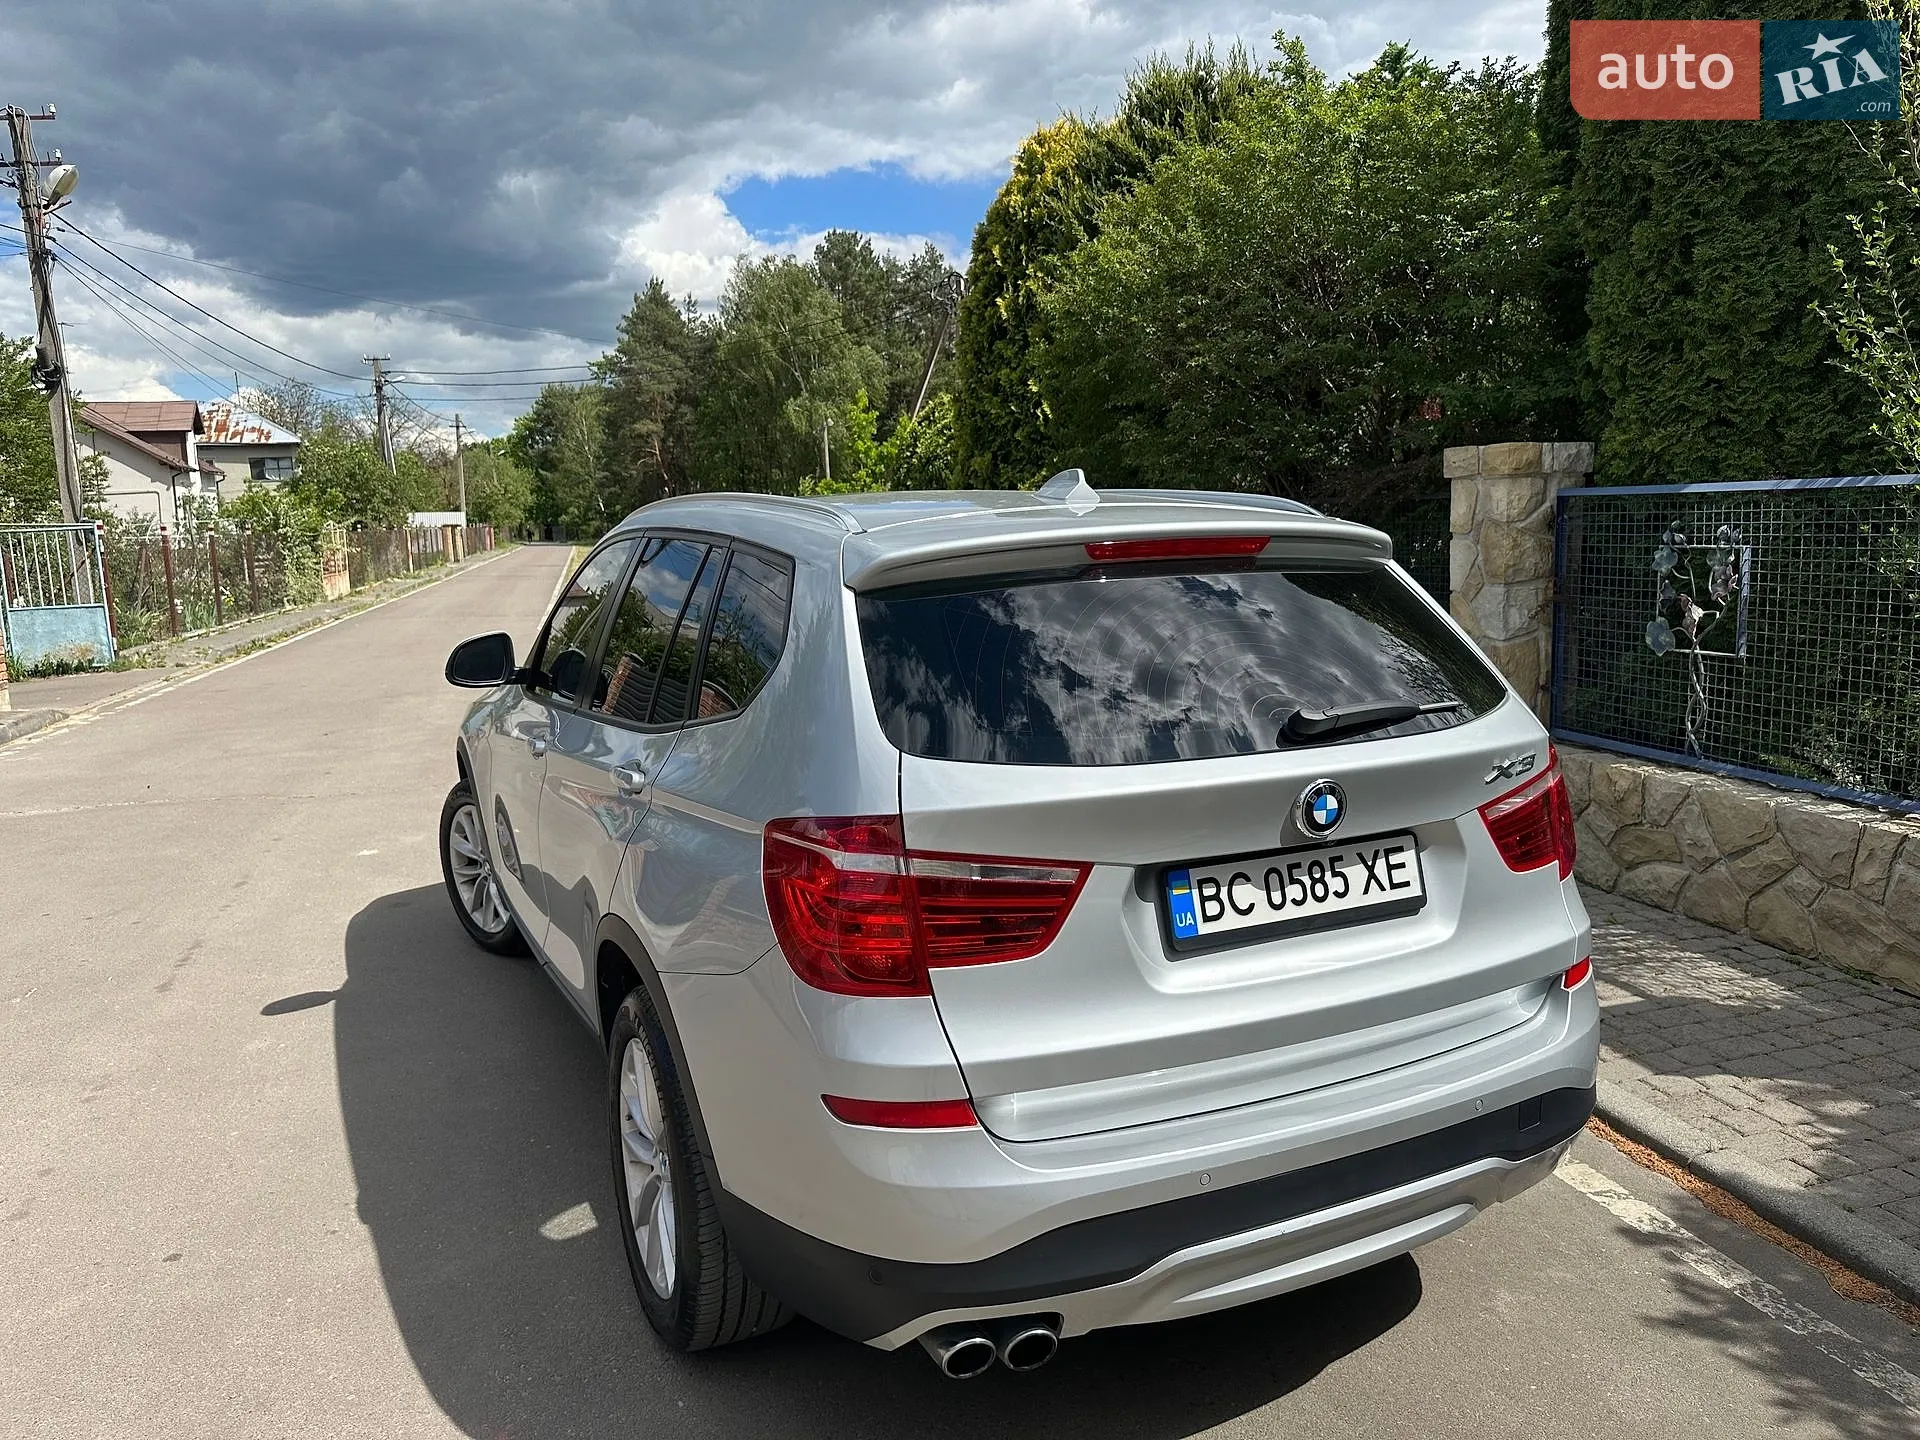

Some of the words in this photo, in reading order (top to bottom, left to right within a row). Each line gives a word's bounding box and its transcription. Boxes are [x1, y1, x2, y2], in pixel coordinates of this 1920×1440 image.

[1483, 752, 1536, 785] X3
[1308, 784, 1341, 804] BMW
[1196, 869, 1255, 923] BC
[1263, 854, 1350, 911] 0585
[1356, 845, 1411, 896] XE
[1176, 911, 1195, 927] UA
